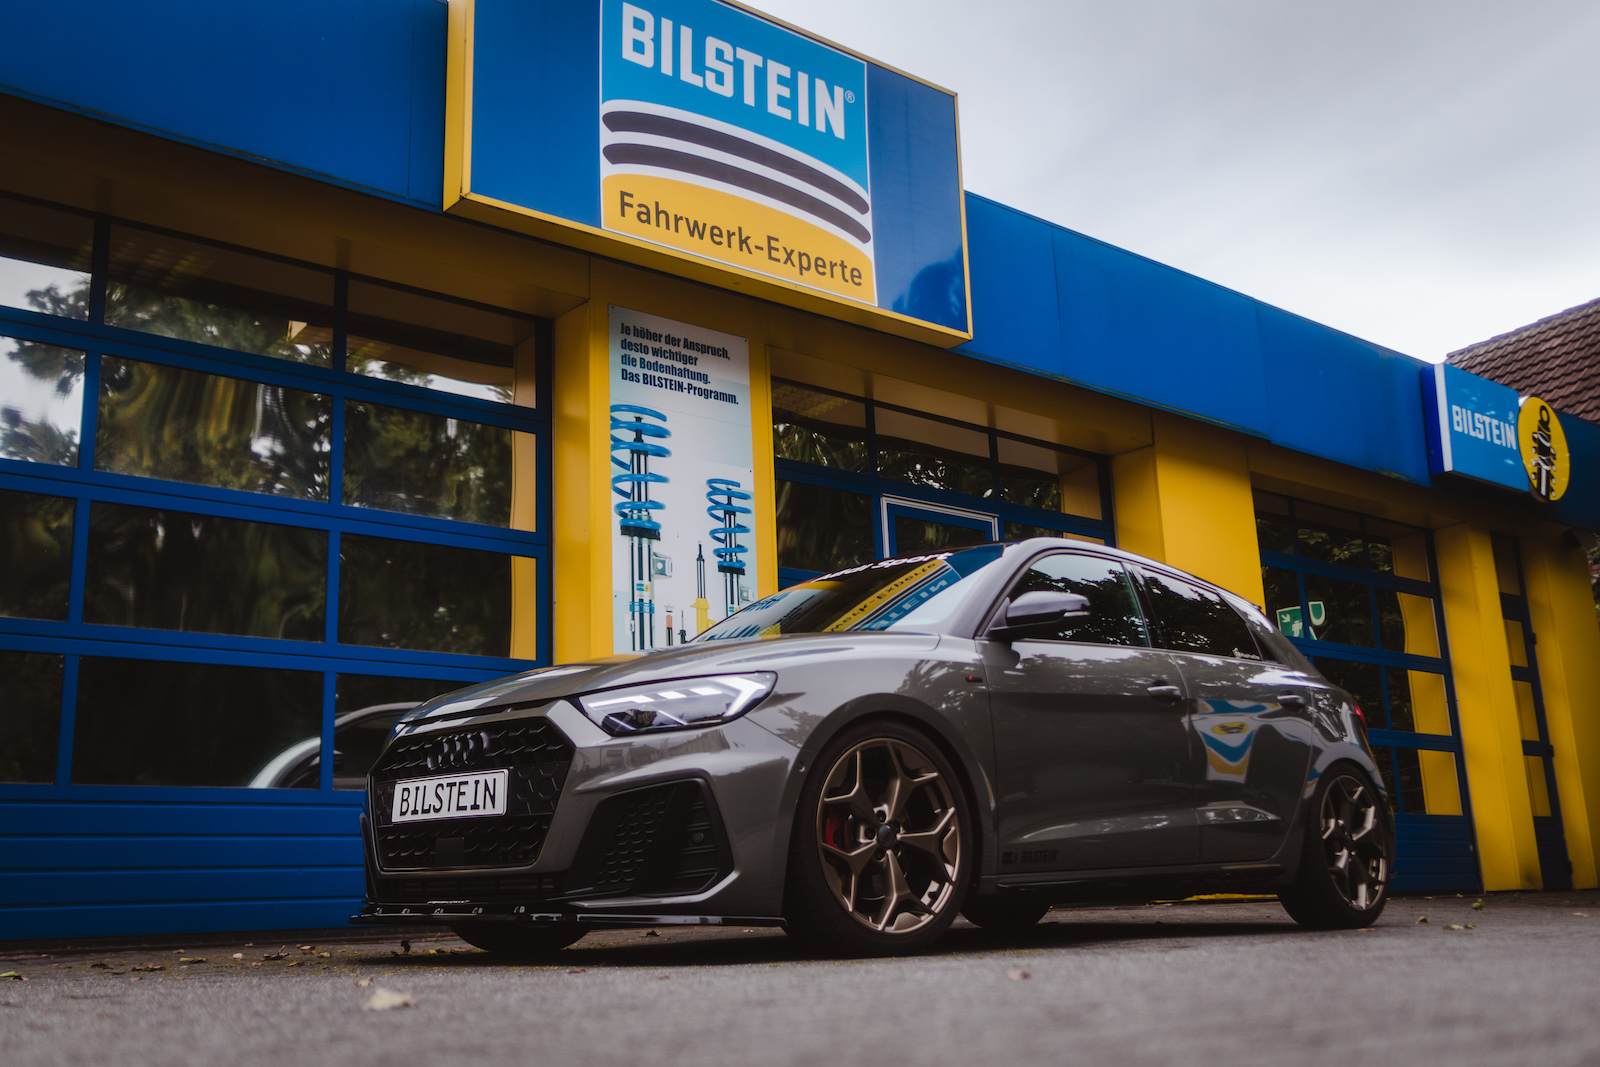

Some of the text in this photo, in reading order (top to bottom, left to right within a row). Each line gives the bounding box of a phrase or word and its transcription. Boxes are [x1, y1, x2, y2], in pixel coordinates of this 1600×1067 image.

[619, 190, 863, 287] Fahrwerk-Experte
[620, 322, 731, 360] Je höher der Anspruch,
[620, 338, 698, 367] desto wichtiger
[621, 353, 711, 385] die Bodenhaftung.
[621, 368, 739, 405] Das BILSTEIN-Programm.
[871, 552, 954, 568] Sport
[399, 778, 496, 816] BILSTEIN
[1021, 850, 1057, 864] BILSTEIN
